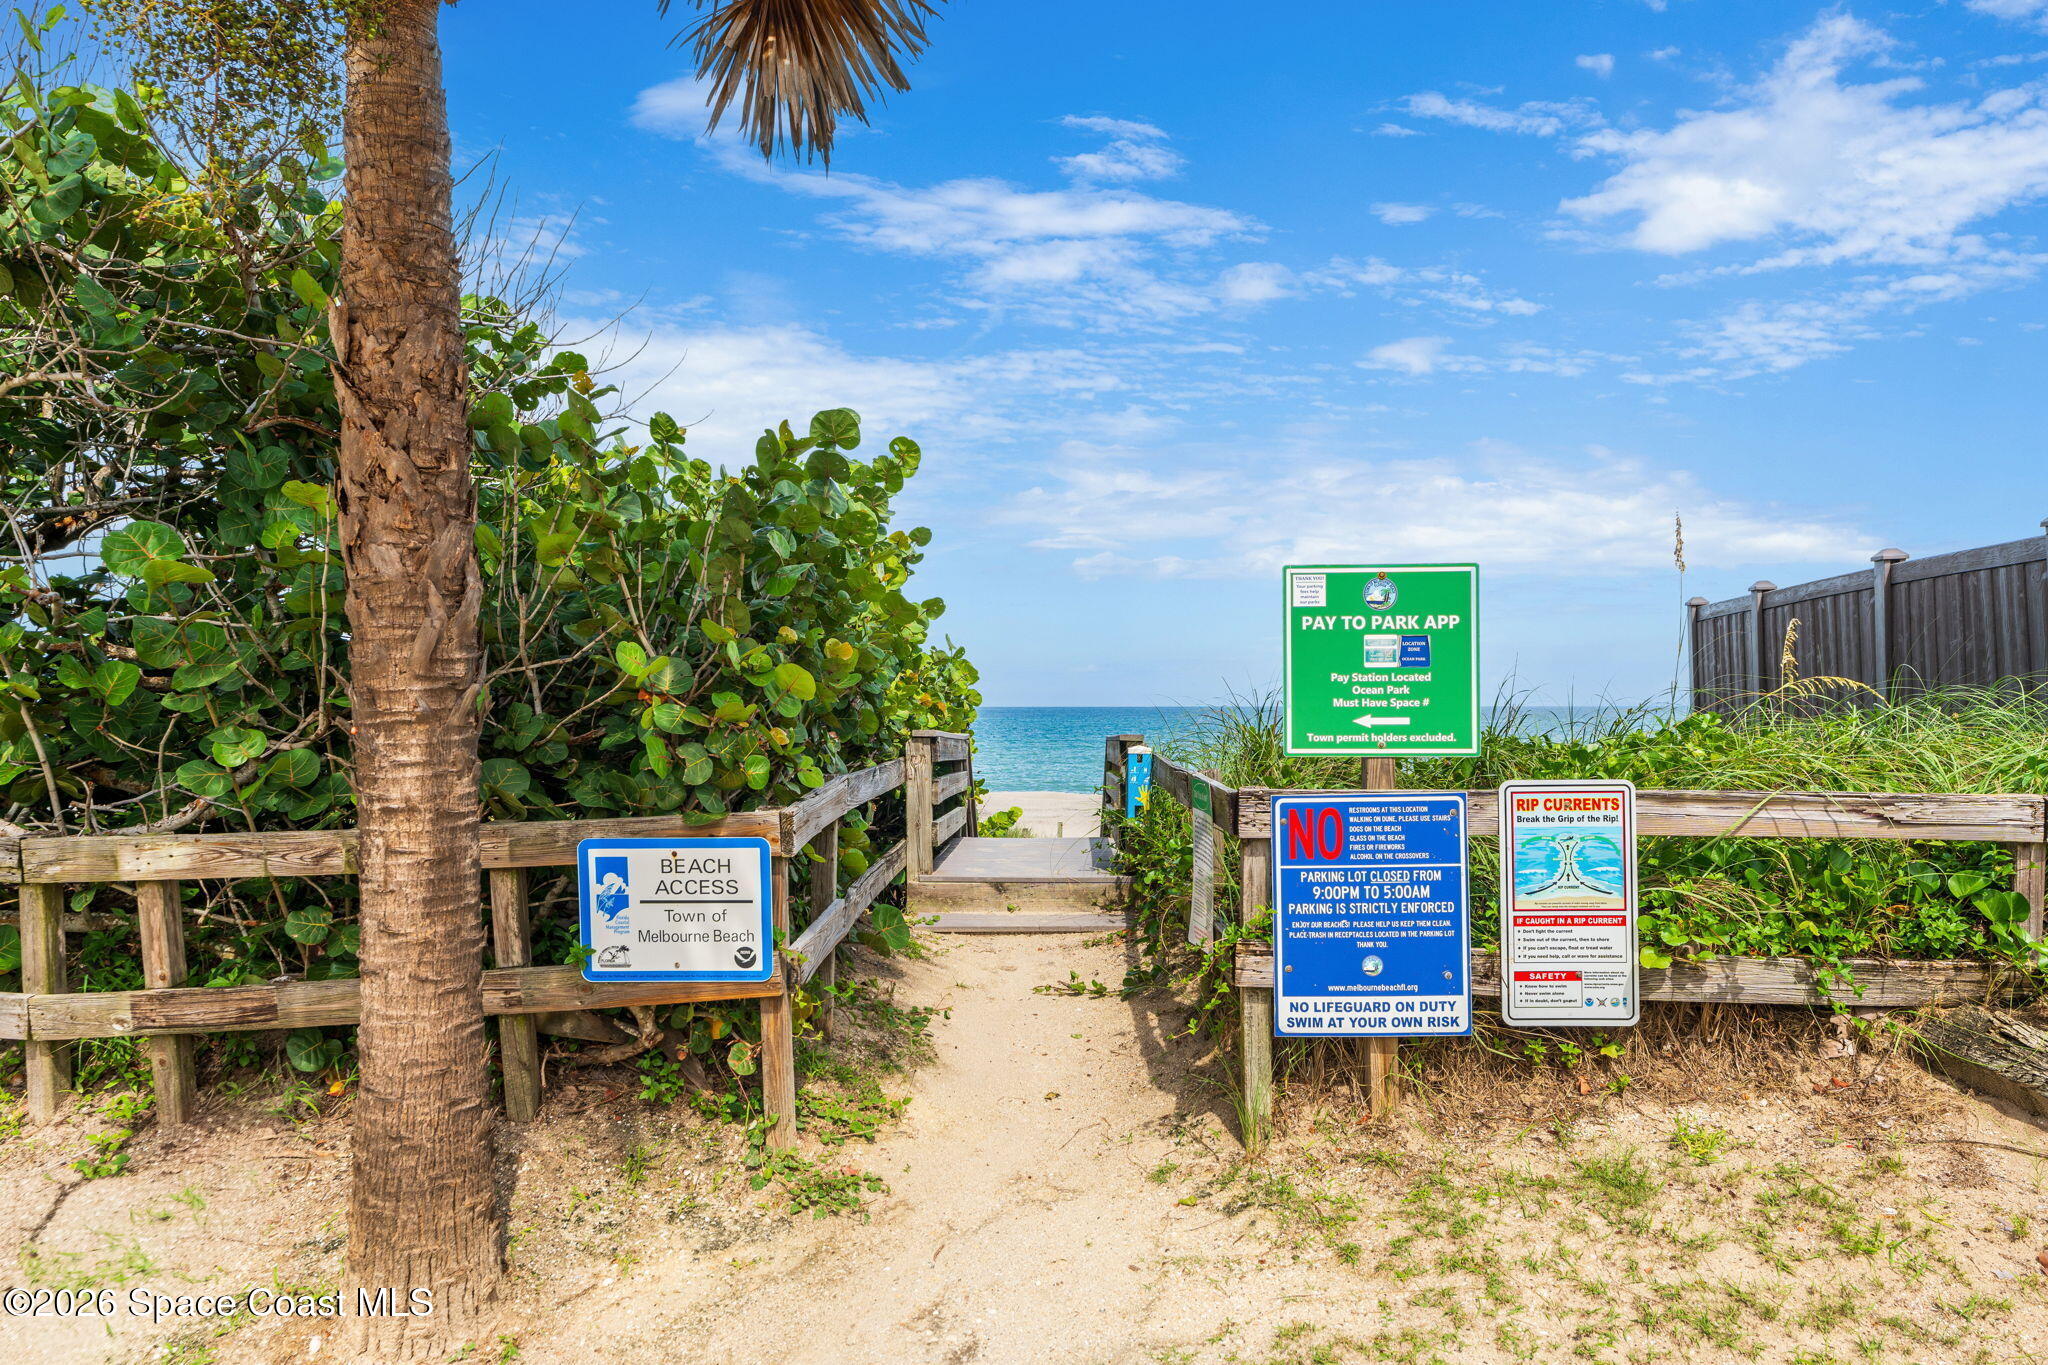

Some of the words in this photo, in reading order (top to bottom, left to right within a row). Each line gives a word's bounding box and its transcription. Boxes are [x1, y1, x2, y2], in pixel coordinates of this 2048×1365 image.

[1302, 616, 1337, 630] PAY
[1341, 616, 1366, 630] TO
[1372, 615, 1419, 629] PARK
[1424, 615, 1460, 629] APP
[1331, 673, 1349, 684] Pay
[1352, 673, 1388, 682] Station
[1392, 672, 1431, 682] Located
[1352, 686, 1383, 694] Ocean
[1387, 686, 1410, 694] Park
[1333, 699, 1359, 707] Must
[1362, 699, 1387, 707] Have
[1390, 698, 1420, 709] Space
[1423, 698, 1430, 706] #
[1307, 733, 1334, 742] Town
[1336, 733, 1369, 743] permit
[1371, 733, 1407, 742] holders
[1410, 733, 1457, 742] excluded.
[1516, 798, 1538, 811] RIP
[1544, 798, 1620, 811] CURRENTS
[1558, 815, 1574, 824] Grip
[1603, 815, 1618, 823] Rip!
[1288, 808, 1343, 860] NO
[661, 858, 731, 874] BEACH
[1300, 872, 1344, 882] PARKING
[1348, 871, 1366, 882] LOT
[1370, 871, 1410, 883] CLOSED
[1413, 870, 1442, 881] FROM
[655, 880, 739, 895] ACCESS
[1312, 886, 1359, 900] 9:00PM
[1363, 886, 1379, 899] TO
[1383, 885, 1430, 898] 5:00AM
[1288, 903, 1332, 914] PARKING
[1336, 903, 1345, 914] IS
[1350, 903, 1397, 914] STRICTLY
[1402, 902, 1454, 913] ENFORCED
[664, 909, 706, 922] Town
[712, 908, 727, 922] of
[638, 930, 710, 943] Melbourne
[713, 929, 755, 942] Beach
[1328, 984, 1418, 992] www.melbournebeachfl.org
[1289, 1002, 1309, 1012] NO
[1314, 1002, 1391, 1012] LIFEGUARD
[1395, 1002, 1415, 1012] ON
[1420, 1001, 1456, 1012] DUTY
[1287, 1018, 1323, 1028] SWIM
[1328, 1018, 1344, 1027] AT
[1349, 1017, 1386, 1027] YOUR
[1391, 1017, 1423, 1027] OWN
[1428, 1016, 1460, 1027] RISK
